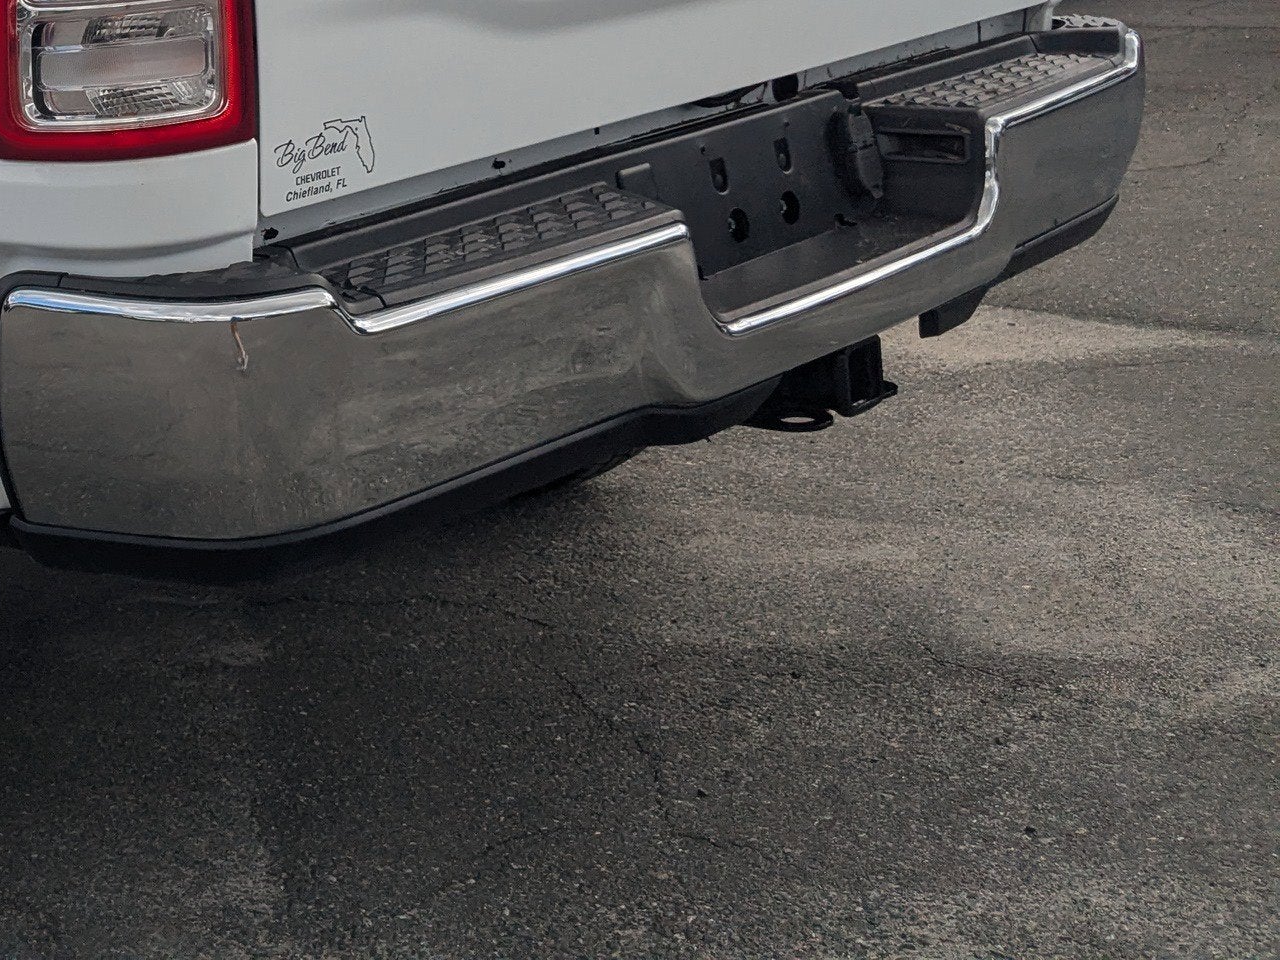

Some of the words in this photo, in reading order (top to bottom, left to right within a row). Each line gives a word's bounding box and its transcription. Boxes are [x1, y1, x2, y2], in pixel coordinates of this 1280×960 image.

[274, 139, 306, 174] Big
[305, 131, 349, 160] Bend
[295, 166, 340, 186] CHEVROLET
[285, 182, 333, 202] Chiefland,
[335, 178, 348, 189] FL
